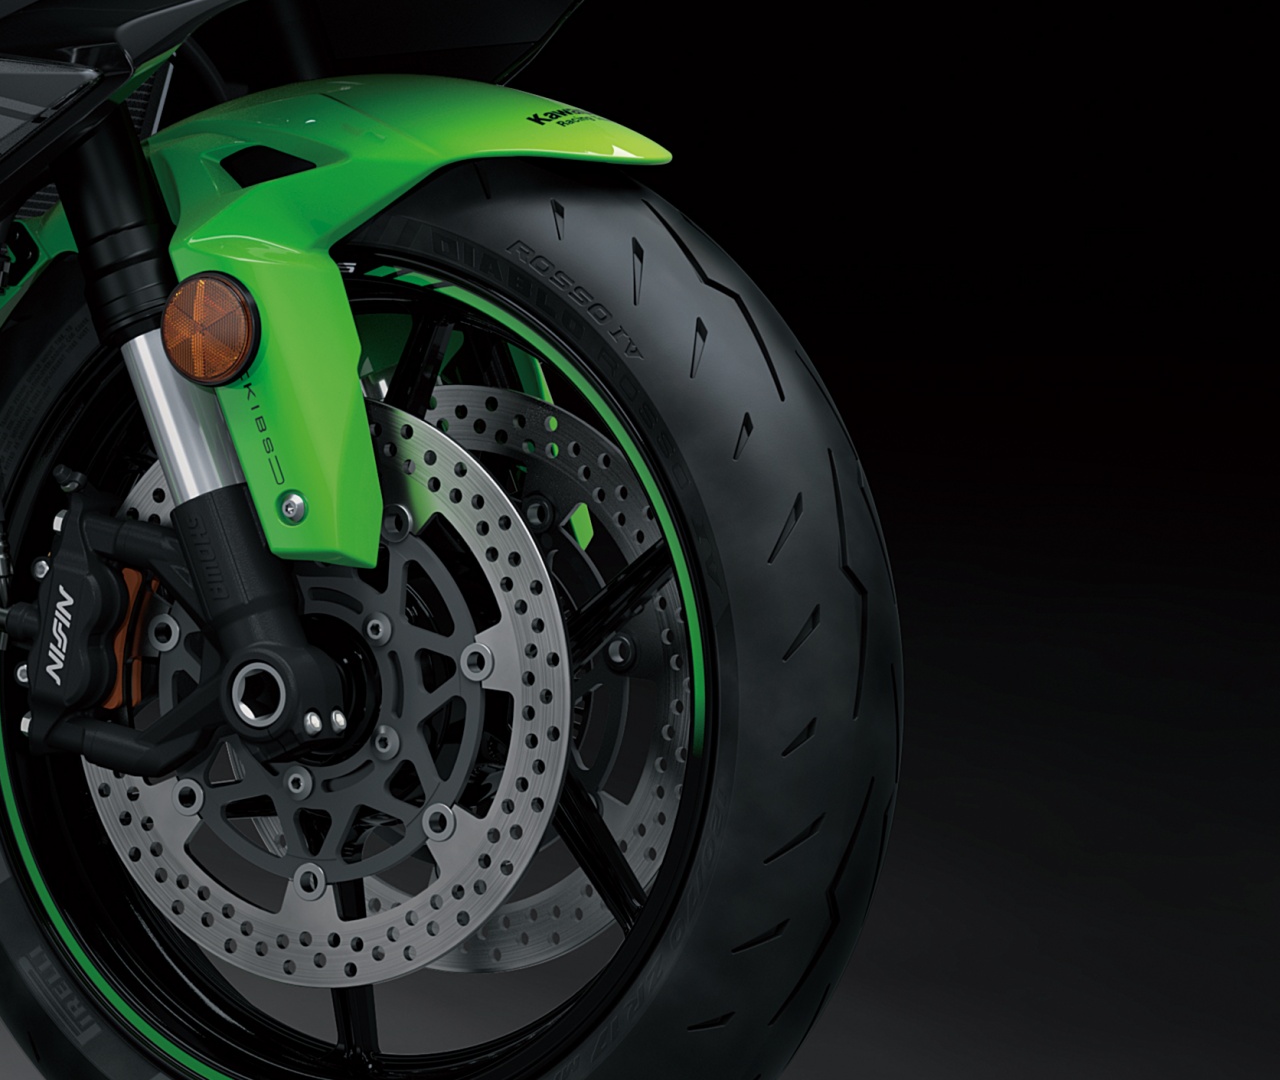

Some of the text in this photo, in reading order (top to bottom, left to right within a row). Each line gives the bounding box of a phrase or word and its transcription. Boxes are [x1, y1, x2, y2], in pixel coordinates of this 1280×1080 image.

[505, 240, 645, 361] ROSSO IV
[186, 510, 230, 600] SHOWA
[46, 584, 74, 686] NISSIN
[18, 944, 104, 1047] PIRELLI
